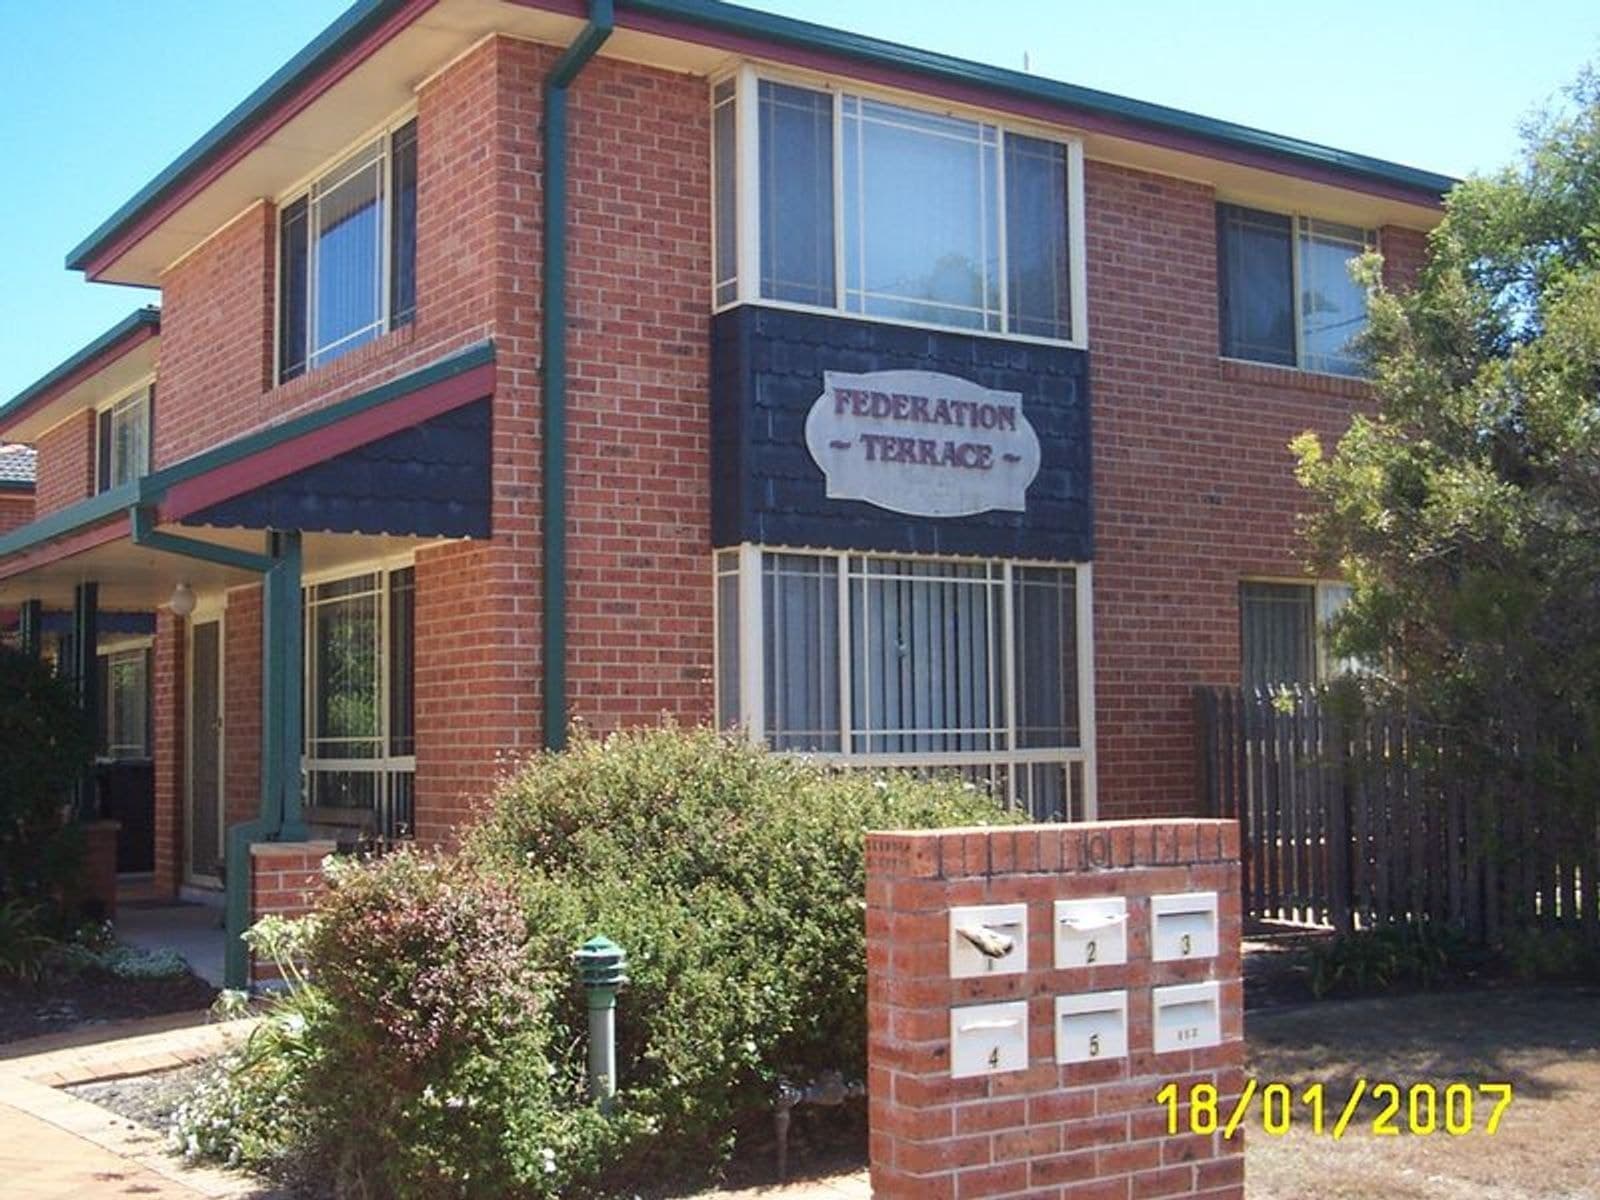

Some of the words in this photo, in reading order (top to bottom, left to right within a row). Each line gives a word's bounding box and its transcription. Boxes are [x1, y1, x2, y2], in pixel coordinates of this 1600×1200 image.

[833, 388, 1017, 432] FEDERATION
[860, 434, 993, 470] TERRACE
[1086, 941, 1097, 963] 2
[1180, 934, 1191, 955] 3
[1088, 1034, 1100, 1056] 5
[987, 1045, 999, 1068] 4
